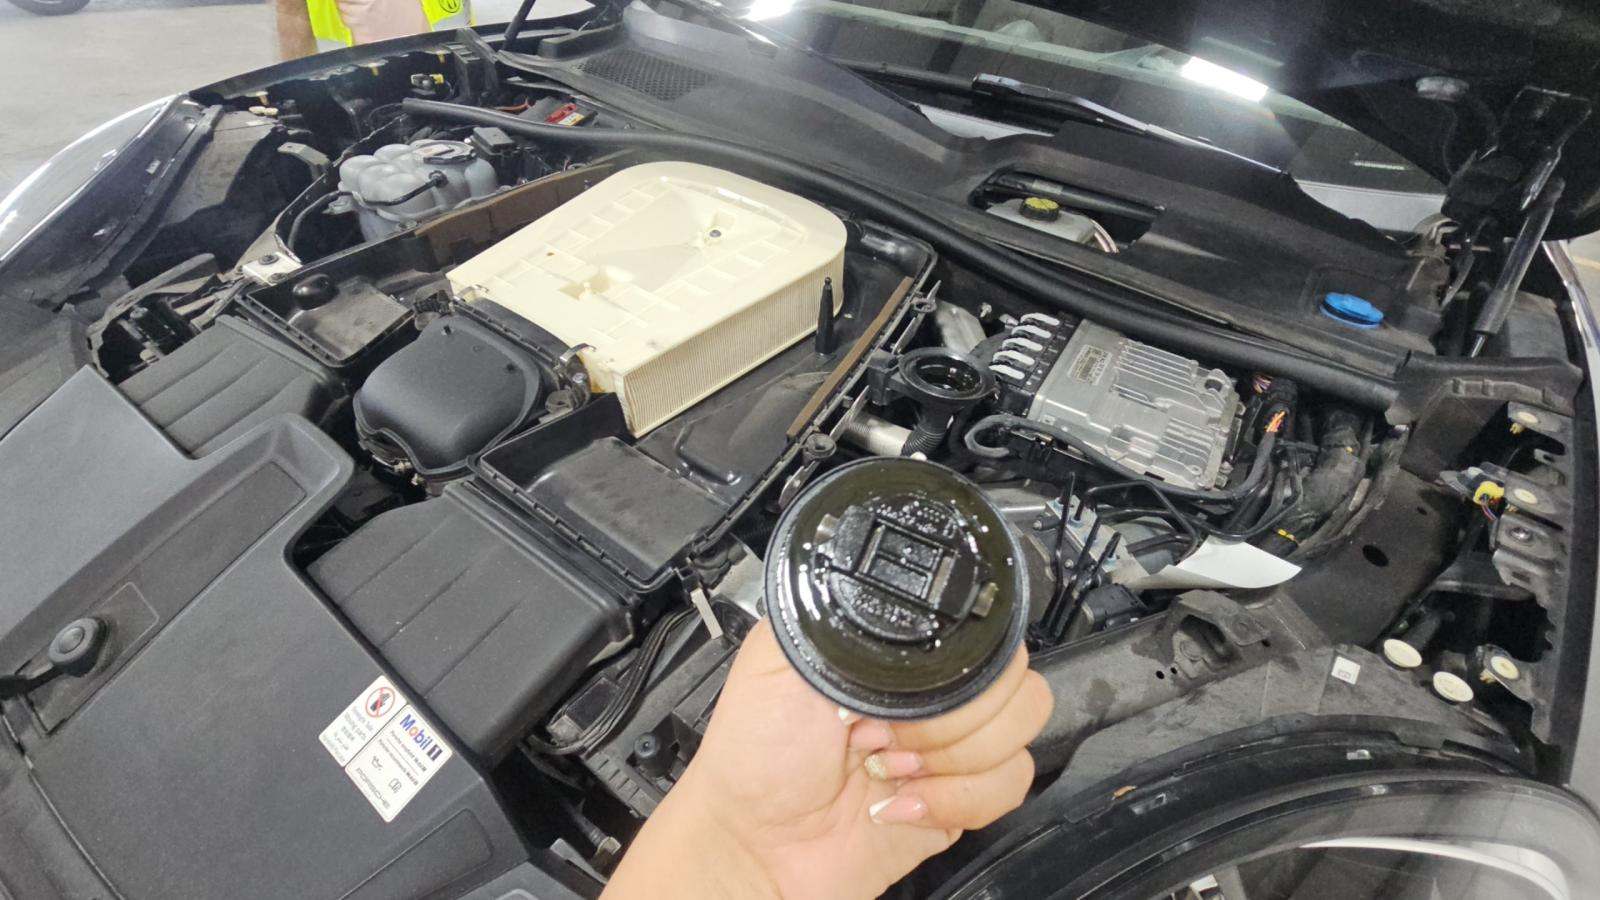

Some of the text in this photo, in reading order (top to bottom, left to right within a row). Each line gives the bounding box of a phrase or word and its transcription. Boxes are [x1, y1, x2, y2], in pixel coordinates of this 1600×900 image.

[400, 714, 433, 750] Mobil
[428, 745, 443, 761] 1
[356, 768, 390, 809] PORSCHE
